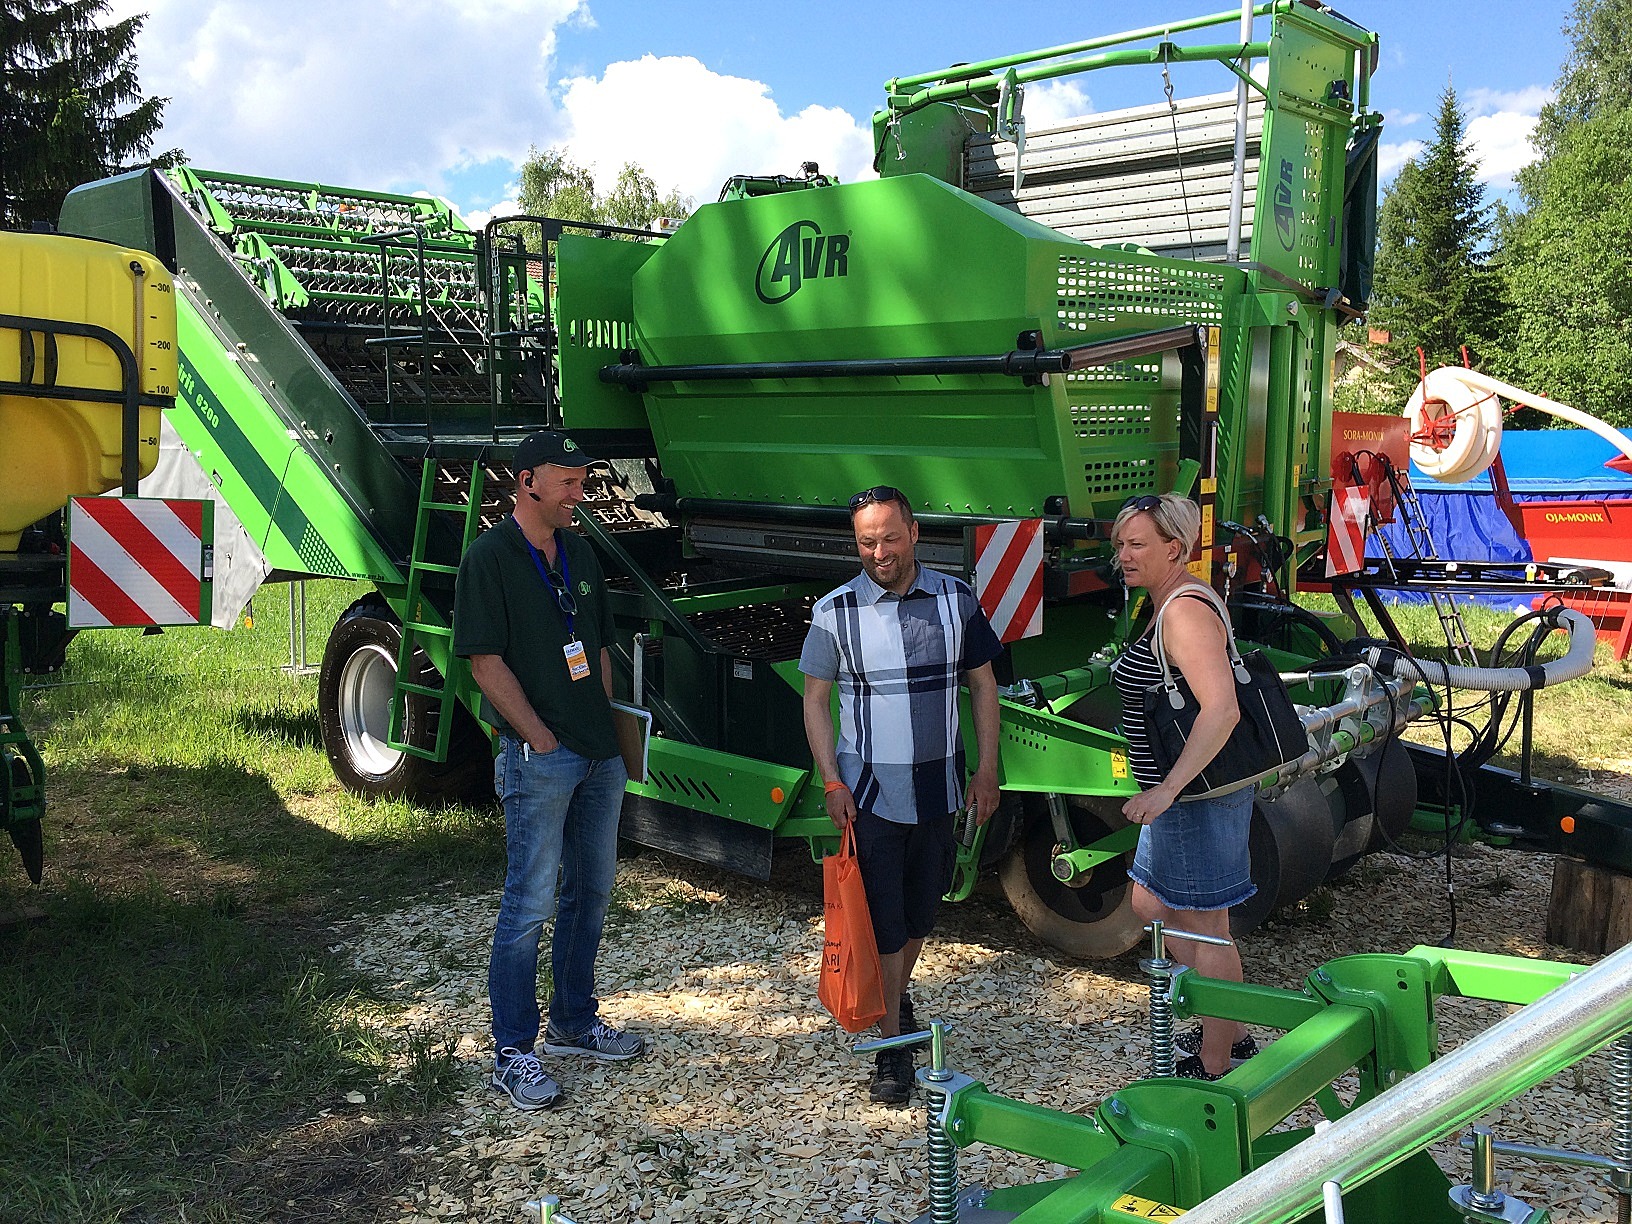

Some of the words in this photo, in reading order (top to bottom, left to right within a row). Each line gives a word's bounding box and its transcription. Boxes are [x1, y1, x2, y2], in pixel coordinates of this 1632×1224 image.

[1274, 158, 1295, 252] AVR
[755, 220, 850, 304] AVR
[157, 283, 170, 293] 300
[157, 340, 171, 350] 200
[156, 385, 170, 394] 100
[177, 362, 196, 395] irit
[195, 393, 219, 428] 6200
[1343, 429, 1385, 442] SORA-MONIX
[148, 437, 157, 446] 50
[1545, 513, 1604, 524] OJA-MONIX
